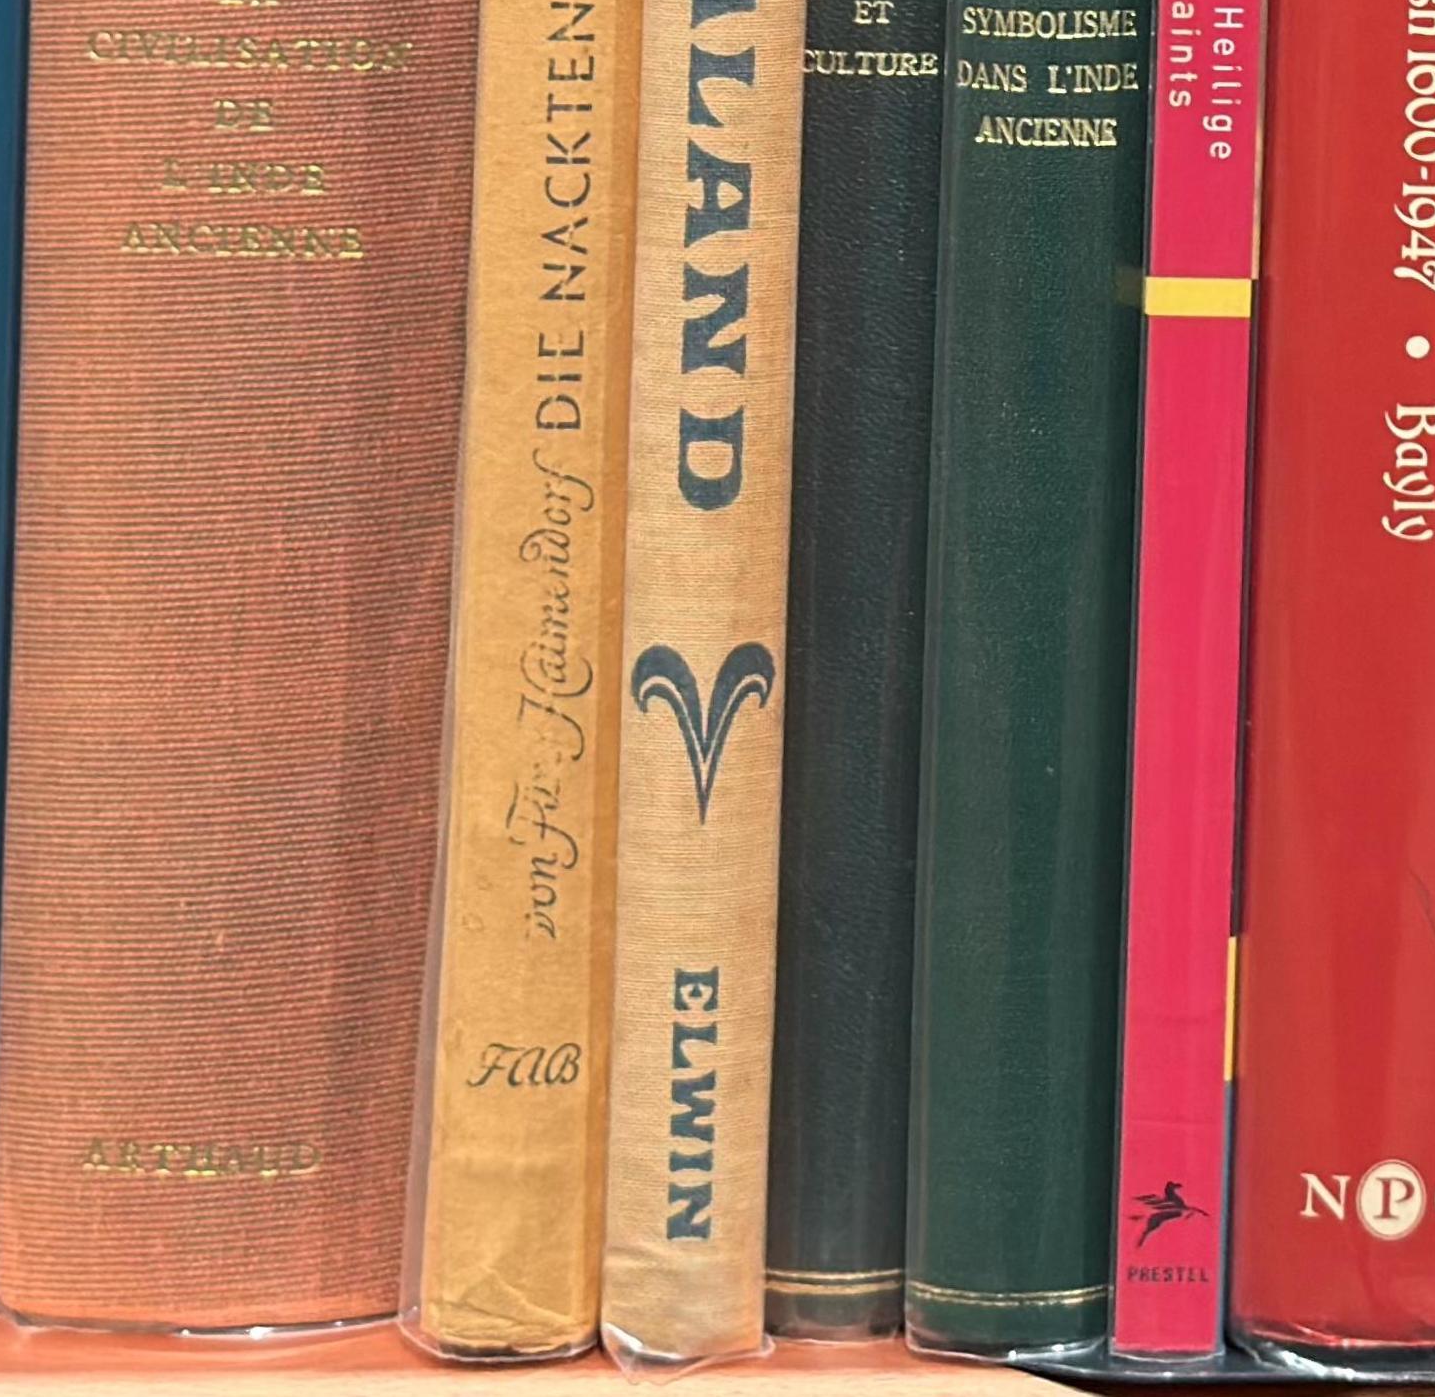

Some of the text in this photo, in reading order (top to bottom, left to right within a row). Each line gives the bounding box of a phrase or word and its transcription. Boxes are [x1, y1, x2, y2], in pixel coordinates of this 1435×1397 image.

[852, 0, 895, 25] ET
[961, 6, 1137, 38] SYMBOLISME
[86, 29, 415, 72] CIVILISATION
[802, 49, 940, 77] CULTURE
[956, 59, 1140, 95] DANS L'INDE
[1201, 6, 1245, 160] Heilige
[213, 98, 274, 132] DE
[974, 115, 1117, 148] ANCIENNE
[538, 1, 596, 302] NACKTEN
[119, 222, 365, 259] ANCIENNE
[535, 329, 586, 431] DIE
[666, 965, 720, 1240] ELWIN
[80, 1137, 322, 1176] ARTHAUD
[1127, 1265, 1210, 1283] PRESTEL
